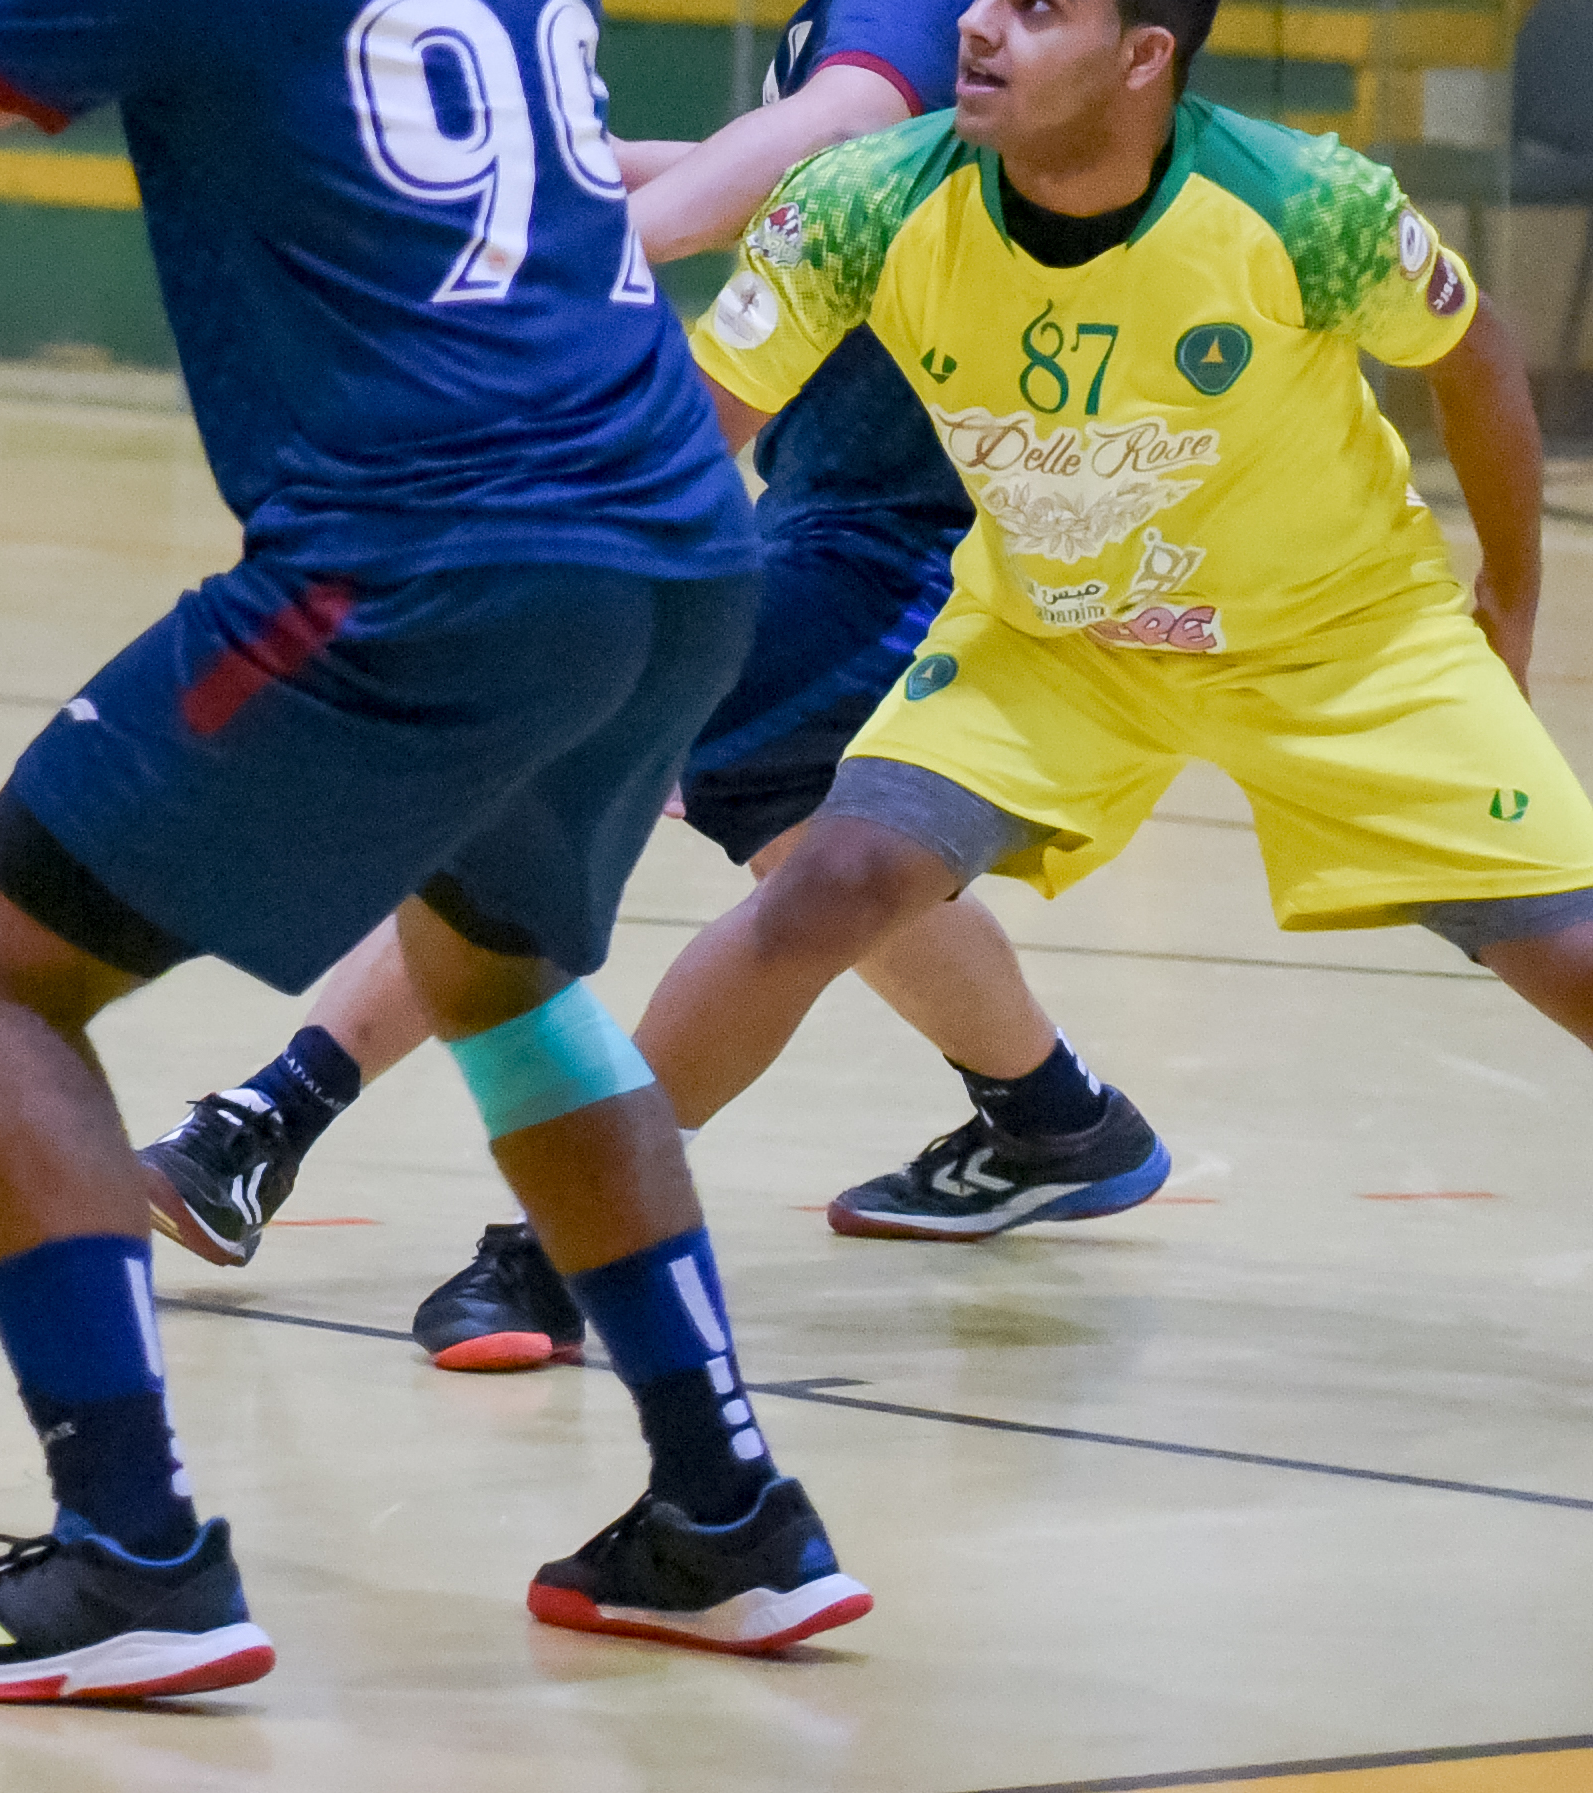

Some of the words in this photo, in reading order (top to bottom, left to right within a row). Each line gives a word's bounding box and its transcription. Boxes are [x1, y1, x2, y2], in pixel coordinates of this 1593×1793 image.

[1019, 298, 1120, 416] 87
[935, 415, 1082, 478] Delle
[1092, 421, 1214, 479] Rose
